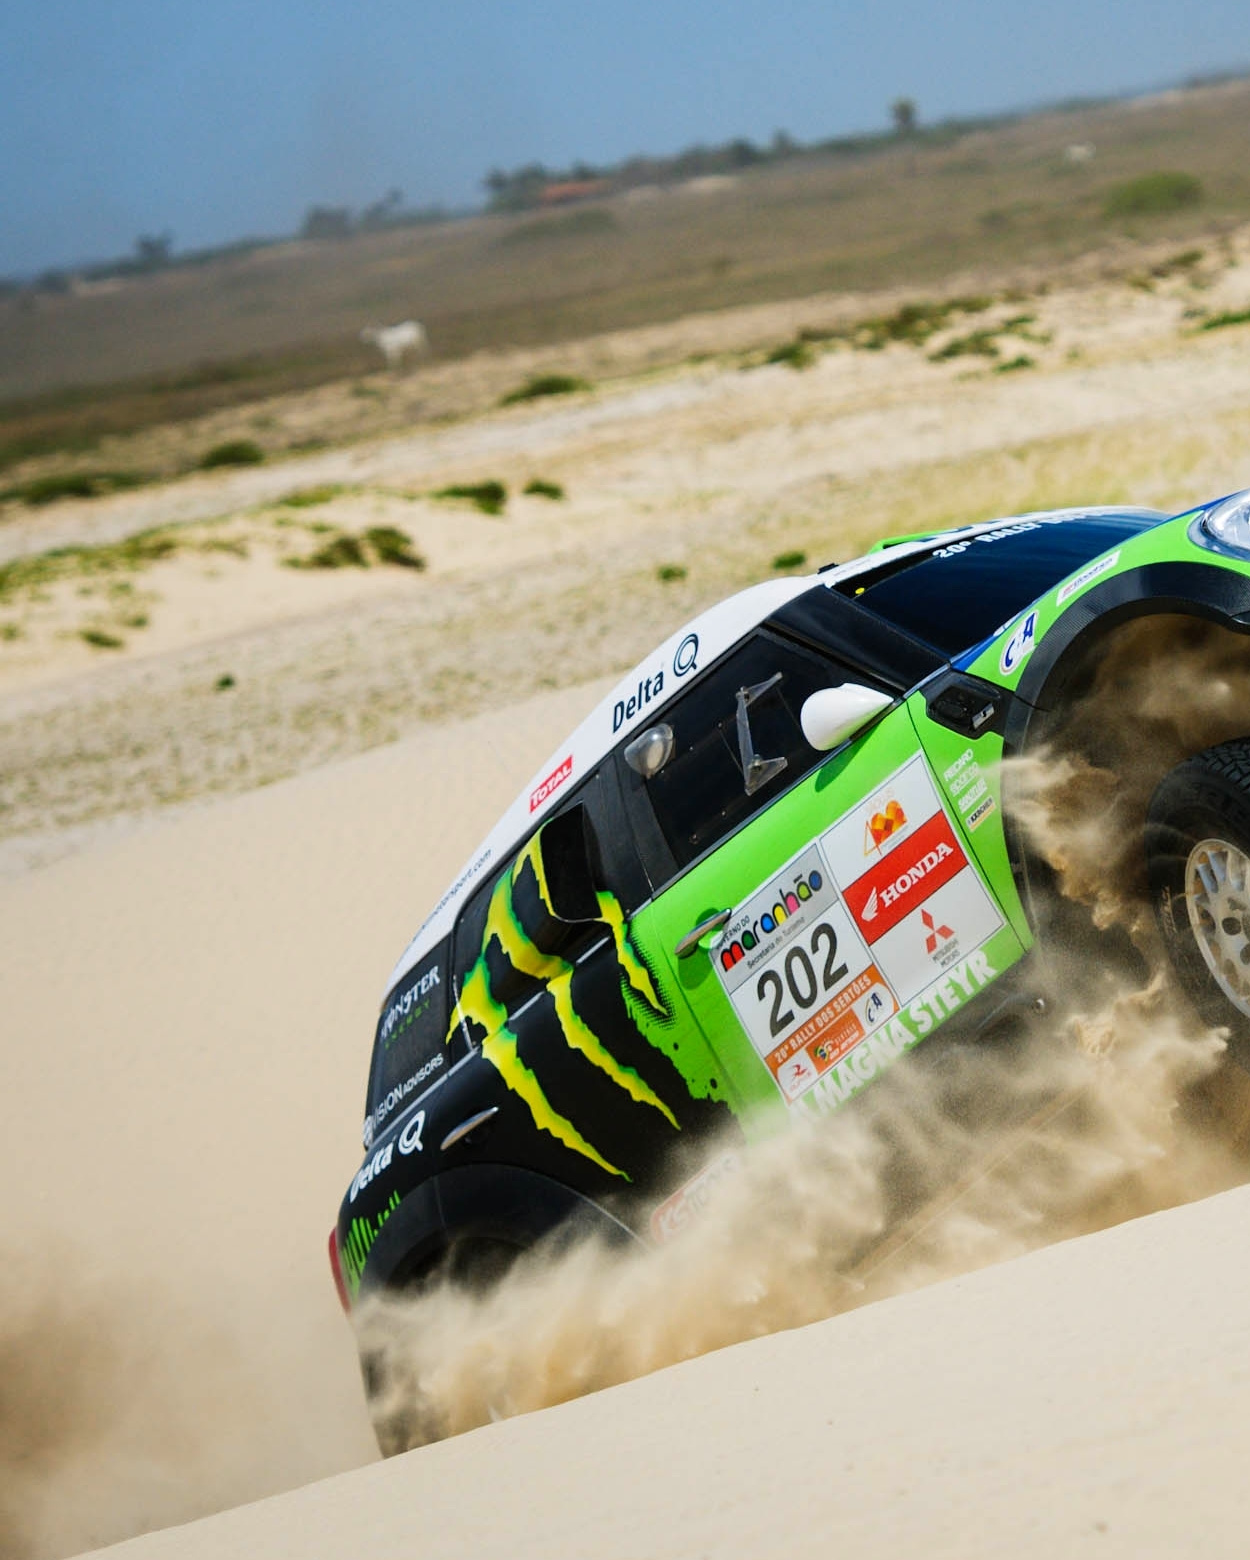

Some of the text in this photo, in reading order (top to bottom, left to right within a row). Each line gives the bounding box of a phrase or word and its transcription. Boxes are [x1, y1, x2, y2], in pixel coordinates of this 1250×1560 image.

[975, 522, 1042, 543] RALLY
[612, 670, 664, 733] Delta
[531, 762, 572, 806] TOTAL
[879, 842, 954, 908] HONDA
[720, 869, 822, 972] maranhão
[757, 922, 849, 1038] 202
[789, 1021, 817, 1051] RALLY
[814, 1006, 836, 1028] DOS
[832, 974, 872, 1010] SERTÕES
[811, 1016, 917, 1117] MAGNA
[909, 947, 999, 1034] STEYR
